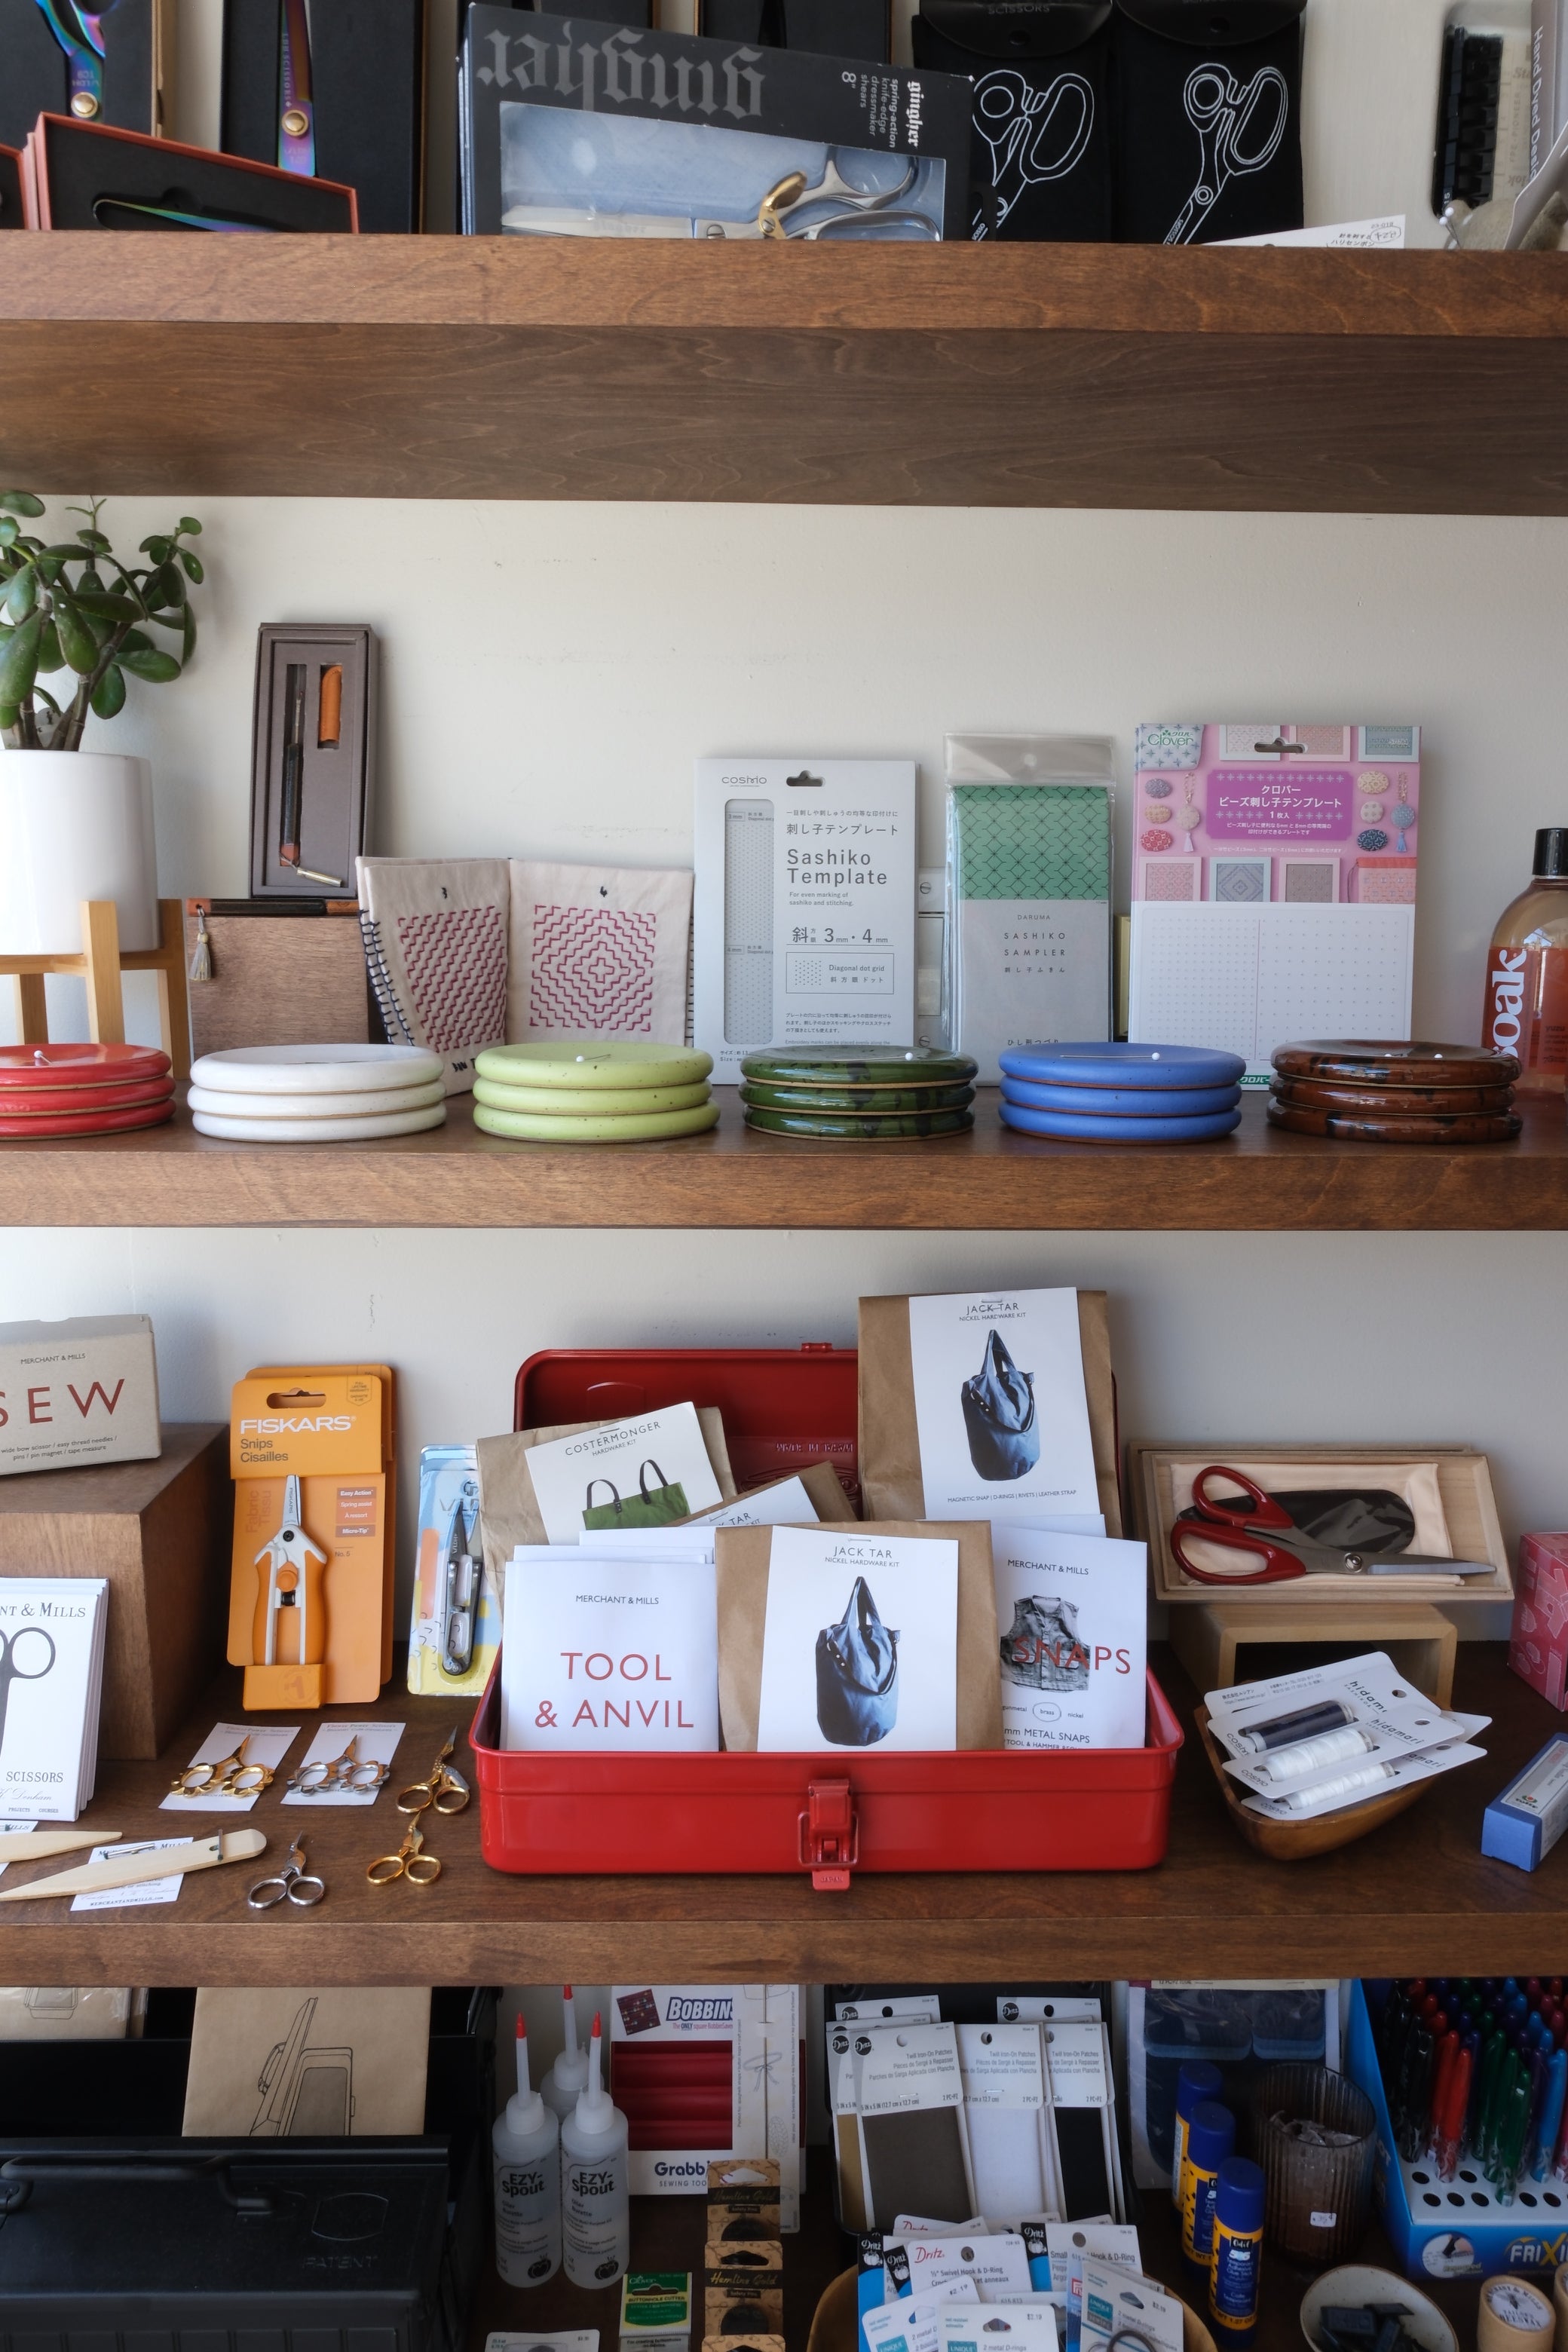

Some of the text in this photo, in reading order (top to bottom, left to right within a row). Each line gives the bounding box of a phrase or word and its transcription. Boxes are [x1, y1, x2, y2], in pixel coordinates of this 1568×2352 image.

[988, 4, 1050, 14] SCISSORS
[1533, 26, 1544, 77] Hand
[859, 74, 870, 109] shears
[869, 75, 880, 136] dressmaker
[878, 77, 890, 133] knife-edge
[889, 78, 899, 148] spring-action
[905, 80, 924, 148] gingher
[1147, 733, 1194, 747] Clover
[1261, 785, 1301, 795] クロバー
[1219, 797, 1342, 808] ビーズ刺し子テンプレート
[786, 823, 899, 837] 刺し子テンプレート
[786, 848, 871, 865] Sashiko
[786, 868, 888, 887] Template
[816, 891, 841, 899] marking
[829, 964, 859, 972] Diagonal
[870, 964, 886, 973] grid
[966, 1302, 1020, 1315] JACK TAR
[21, 1355, 59, 1364] MERCHANT
[72, 1438, 90, 1447] thread
[240, 1438, 274, 1452] Snips
[565, 1420, 661, 1456] COSTERMONGER
[592, 1438, 637, 1457] HARDWARE KIT
[240, 1450, 289, 1463] Cisailles
[246, 1490, 259, 1533] Fabric
[259, 1490, 271, 1527] Tissu
[729, 1511, 752, 1526] TAR
[834, 1546, 892, 1558] JACK TAR
[825, 1557, 849, 1565] NICKEL
[850, 1558, 888, 1567] HARDWARE
[1008, 1559, 1057, 1572] MERCHANT
[1066, 1566, 1089, 1576] MILLS
[576, 1595, 626, 1604] MERCHANT
[635, 1597, 659, 1605] MILLS
[21, 1604, 35, 1616] &
[1014, 1636, 1131, 1674] SNAPS
[560, 1652, 672, 1681] TOOL
[534, 1699, 694, 1729] & ANVIL
[1024, 1728, 1090, 1744] METAL SNAPS
[1370, 1718, 1425, 1745] hidamari
[6, 1772, 64, 1783] SCISSORS
[571, 2179, 614, 2197] Spout
[1024, 2227, 1044, 2237] Dritz
[861, 2239, 881, 2250] Dritz
[302, 2255, 373, 2268] PATENT
[914, 2246, 943, 2263] Dritz
[1050, 2250, 1135, 2262] Small D-Ring
[983, 2267, 1003, 2275] D-Ring
[1006, 2344, 1027, 2352] D-rings
